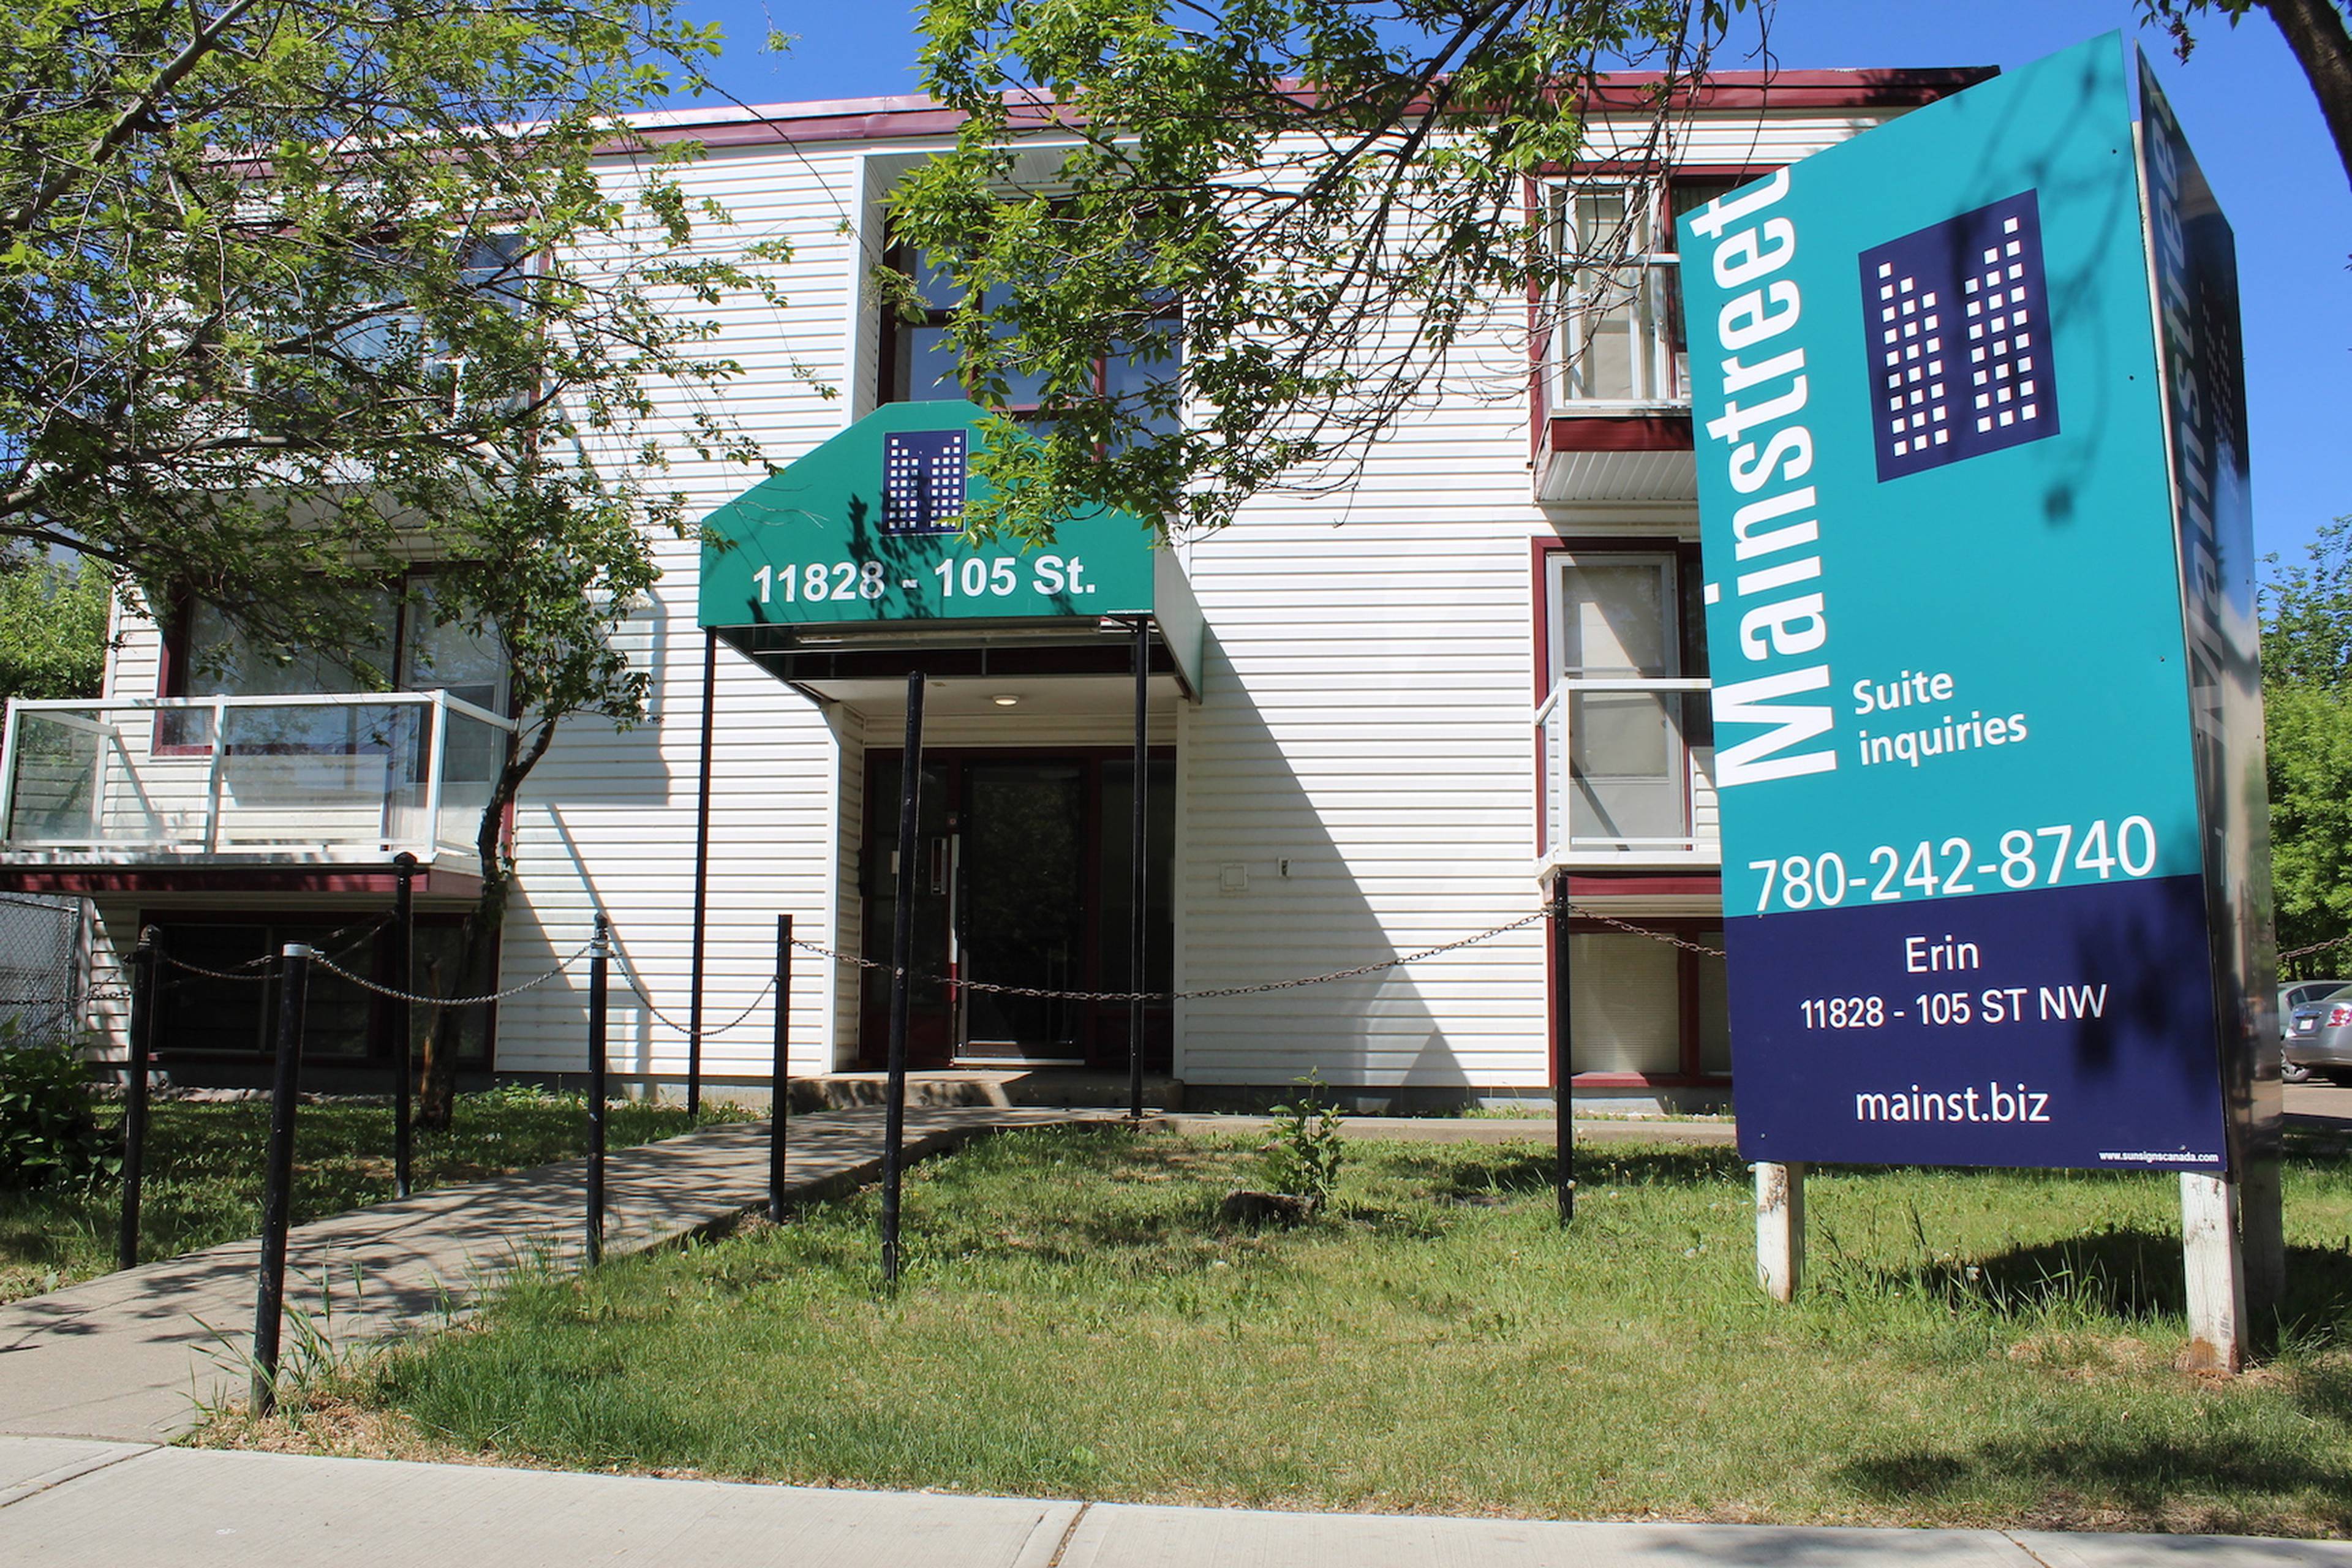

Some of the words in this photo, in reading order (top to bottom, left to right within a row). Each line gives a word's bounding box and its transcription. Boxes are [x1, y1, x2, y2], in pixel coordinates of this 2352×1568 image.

[1689, 166, 1837, 788] Mainstreet
[753, 560, 885, 603] 11828
[934, 557, 1017, 597] 105
[1032, 554, 1096, 595] St.
[1852, 670, 1953, 715] Suite
[1859, 710, 2027, 767] inquiries
[1749, 815, 2156, 912] 780-242-8740
[1905, 935, 1980, 973] Erin
[1800, 996, 1884, 1029] 11828
[1915, 992, 1971, 1025] 105
[1981, 987, 2028, 1023] ST
[2039, 984, 2108, 1021] NW
[1855, 1082, 2051, 1123] mainst.biz
[2098, 1151, 2220, 1164] www.sunsignscanada.com
